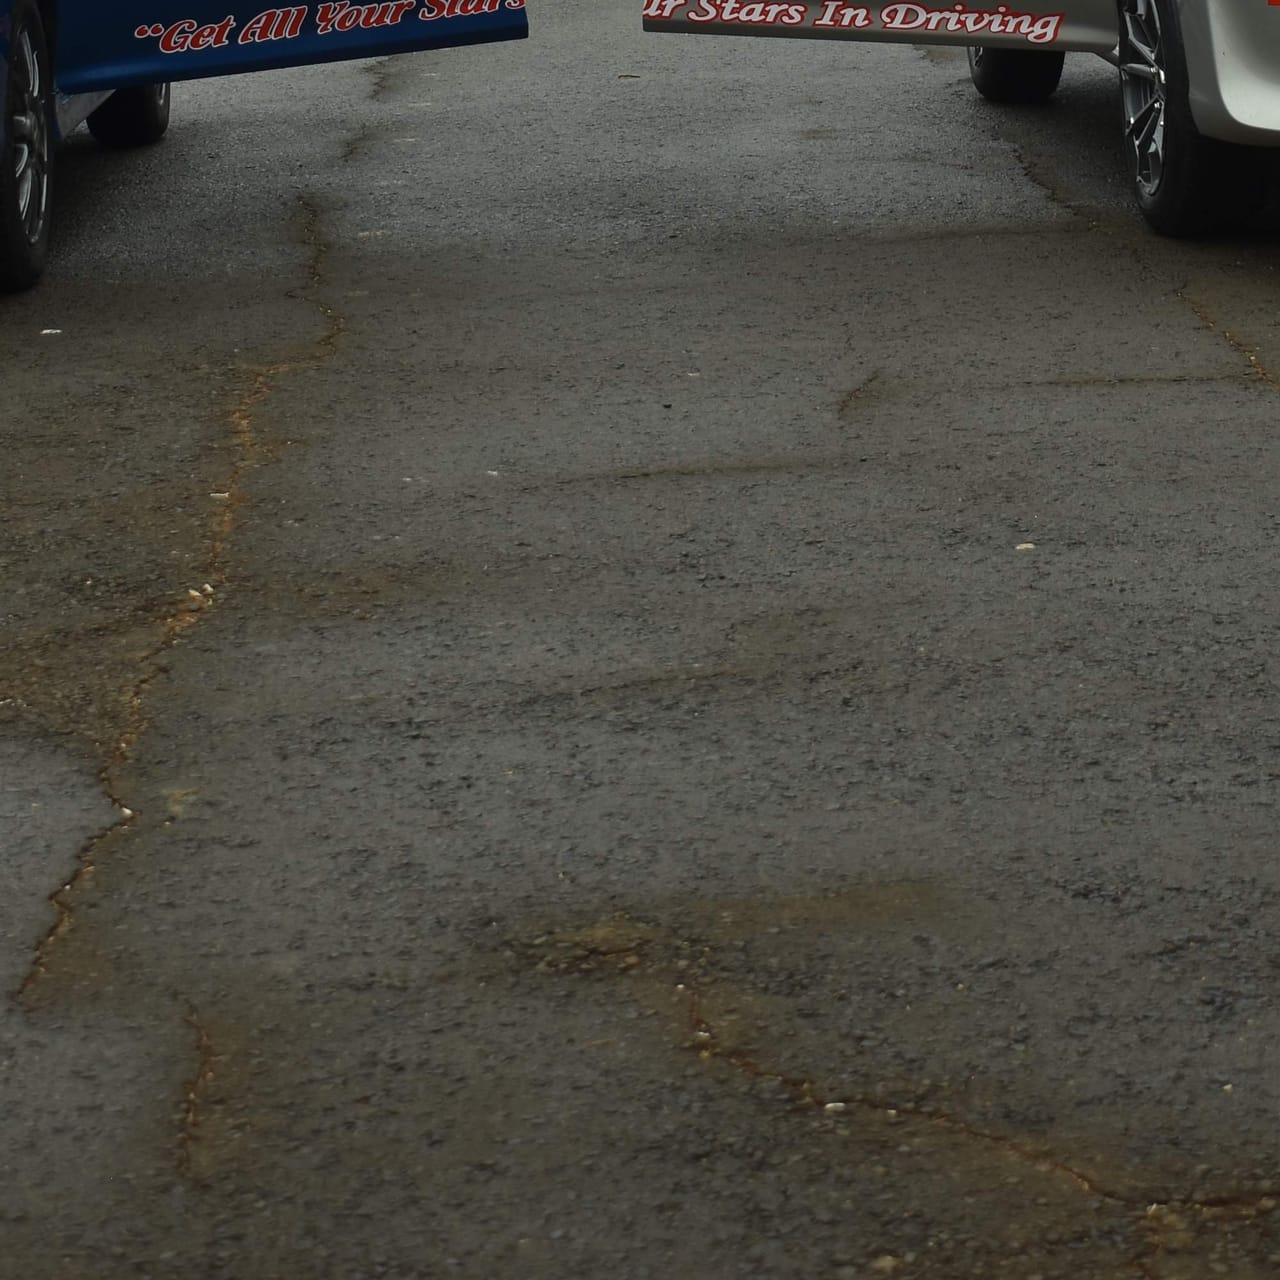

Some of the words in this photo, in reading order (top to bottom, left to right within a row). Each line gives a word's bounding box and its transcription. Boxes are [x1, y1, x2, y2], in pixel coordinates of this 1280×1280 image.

[239, 2, 307, 44] All
[814, 0, 870, 28] In
[881, 2, 1061, 44] Driving
